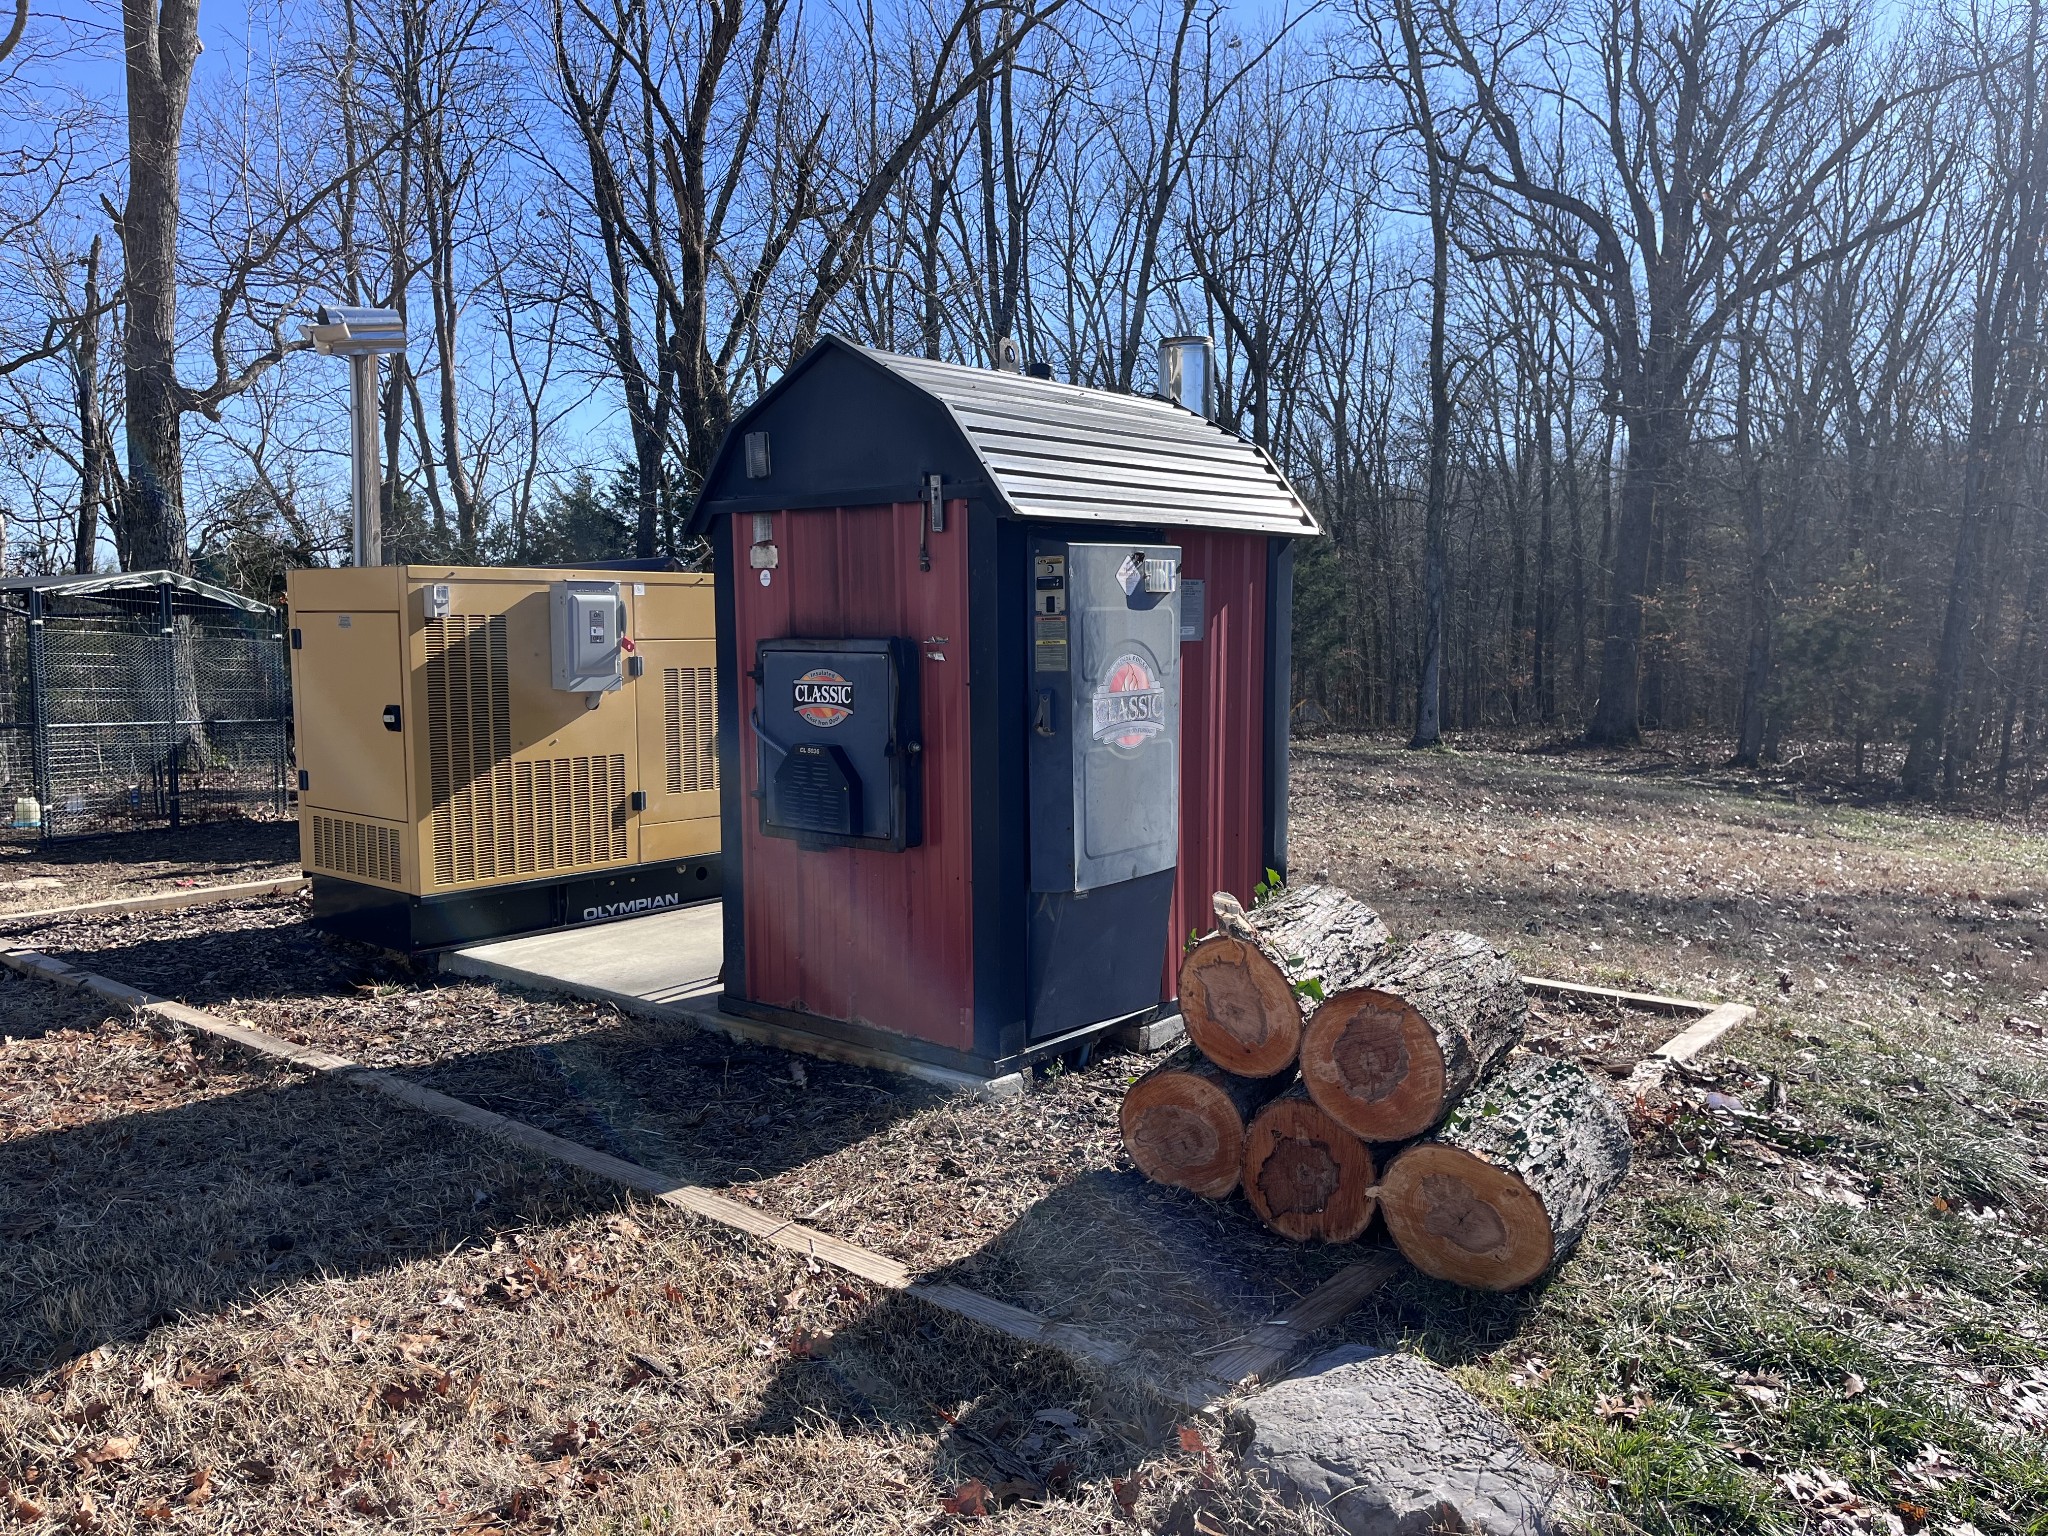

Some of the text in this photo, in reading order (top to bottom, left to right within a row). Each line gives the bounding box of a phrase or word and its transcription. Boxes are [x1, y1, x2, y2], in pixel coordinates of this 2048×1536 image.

[810, 670, 835, 679] Insulated
[794, 684, 852, 704] CLASSIC
[1096, 694, 1163, 723] CLASSIC
[806, 713, 817, 724] Cast
[829, 715, 840, 725] Door
[583, 892, 679, 921] OLYMPIAN
